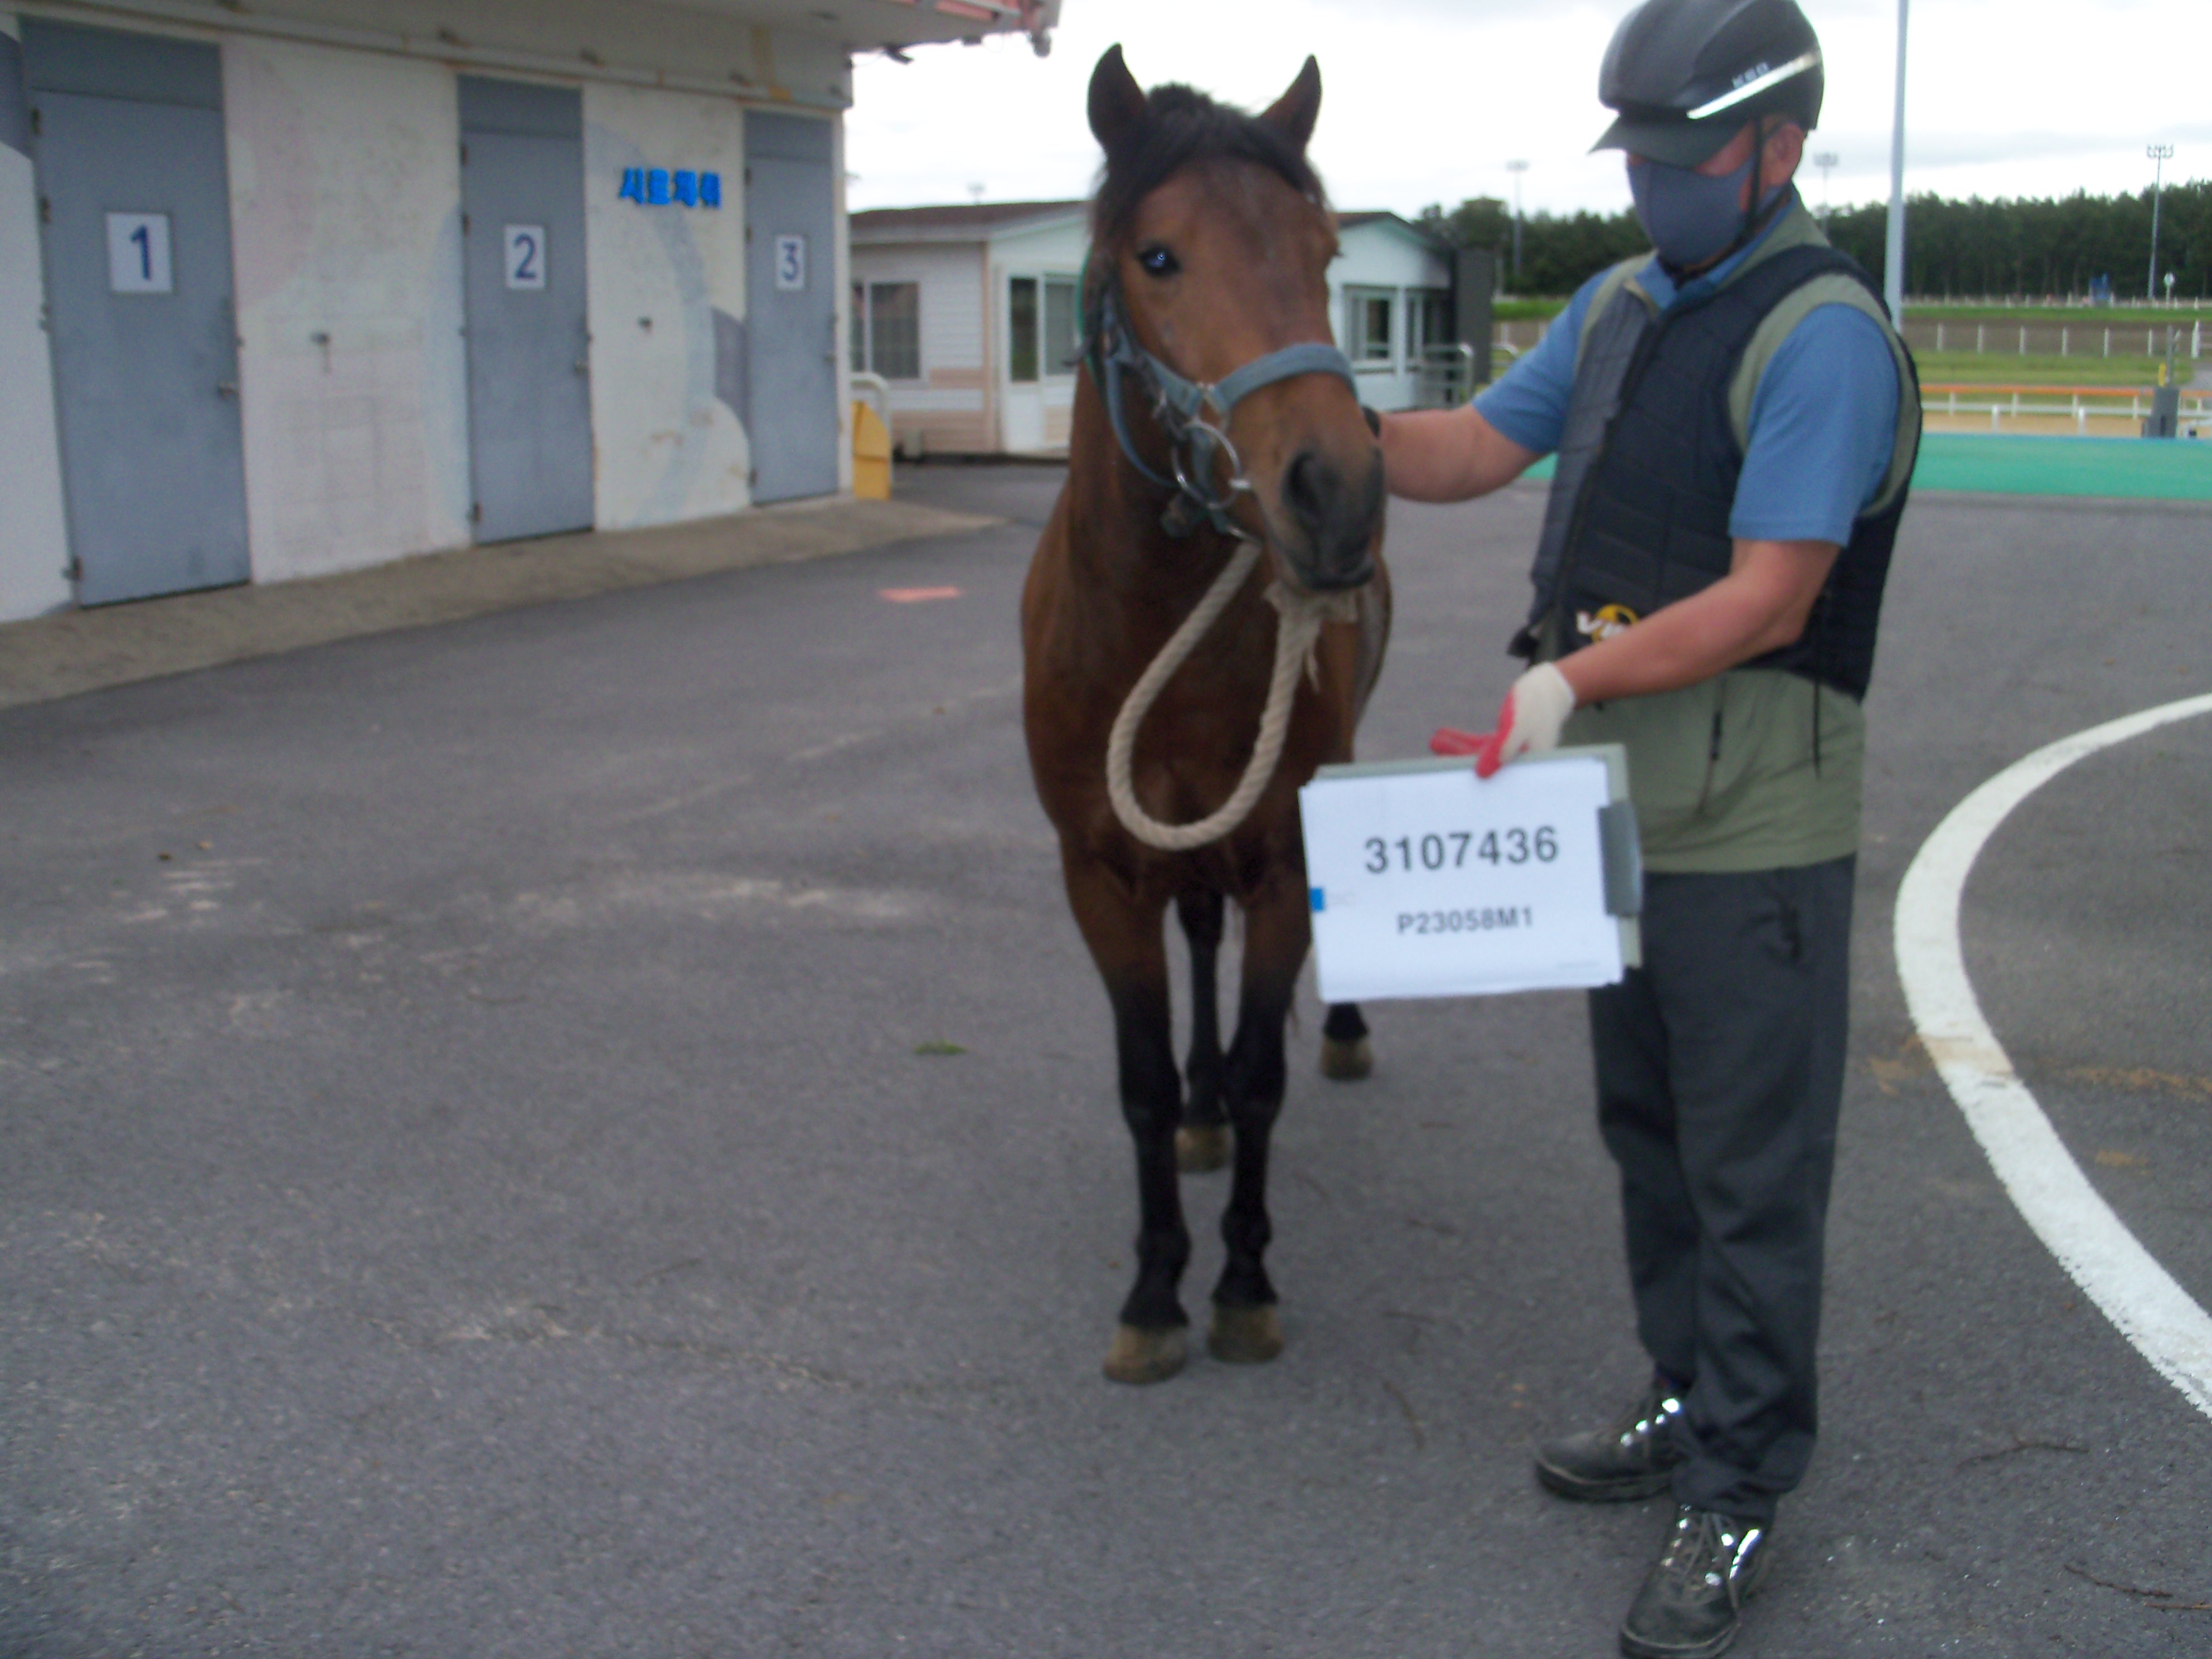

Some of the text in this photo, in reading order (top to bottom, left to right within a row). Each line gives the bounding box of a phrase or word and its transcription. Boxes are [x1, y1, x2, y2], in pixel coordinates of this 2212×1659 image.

[130, 225, 150, 280] 1
[514, 233, 536, 279] 2
[780, 242, 797, 280] 3
[1365, 826, 1559, 874] 3107436
[1398, 906, 1532, 934] P23058M1
